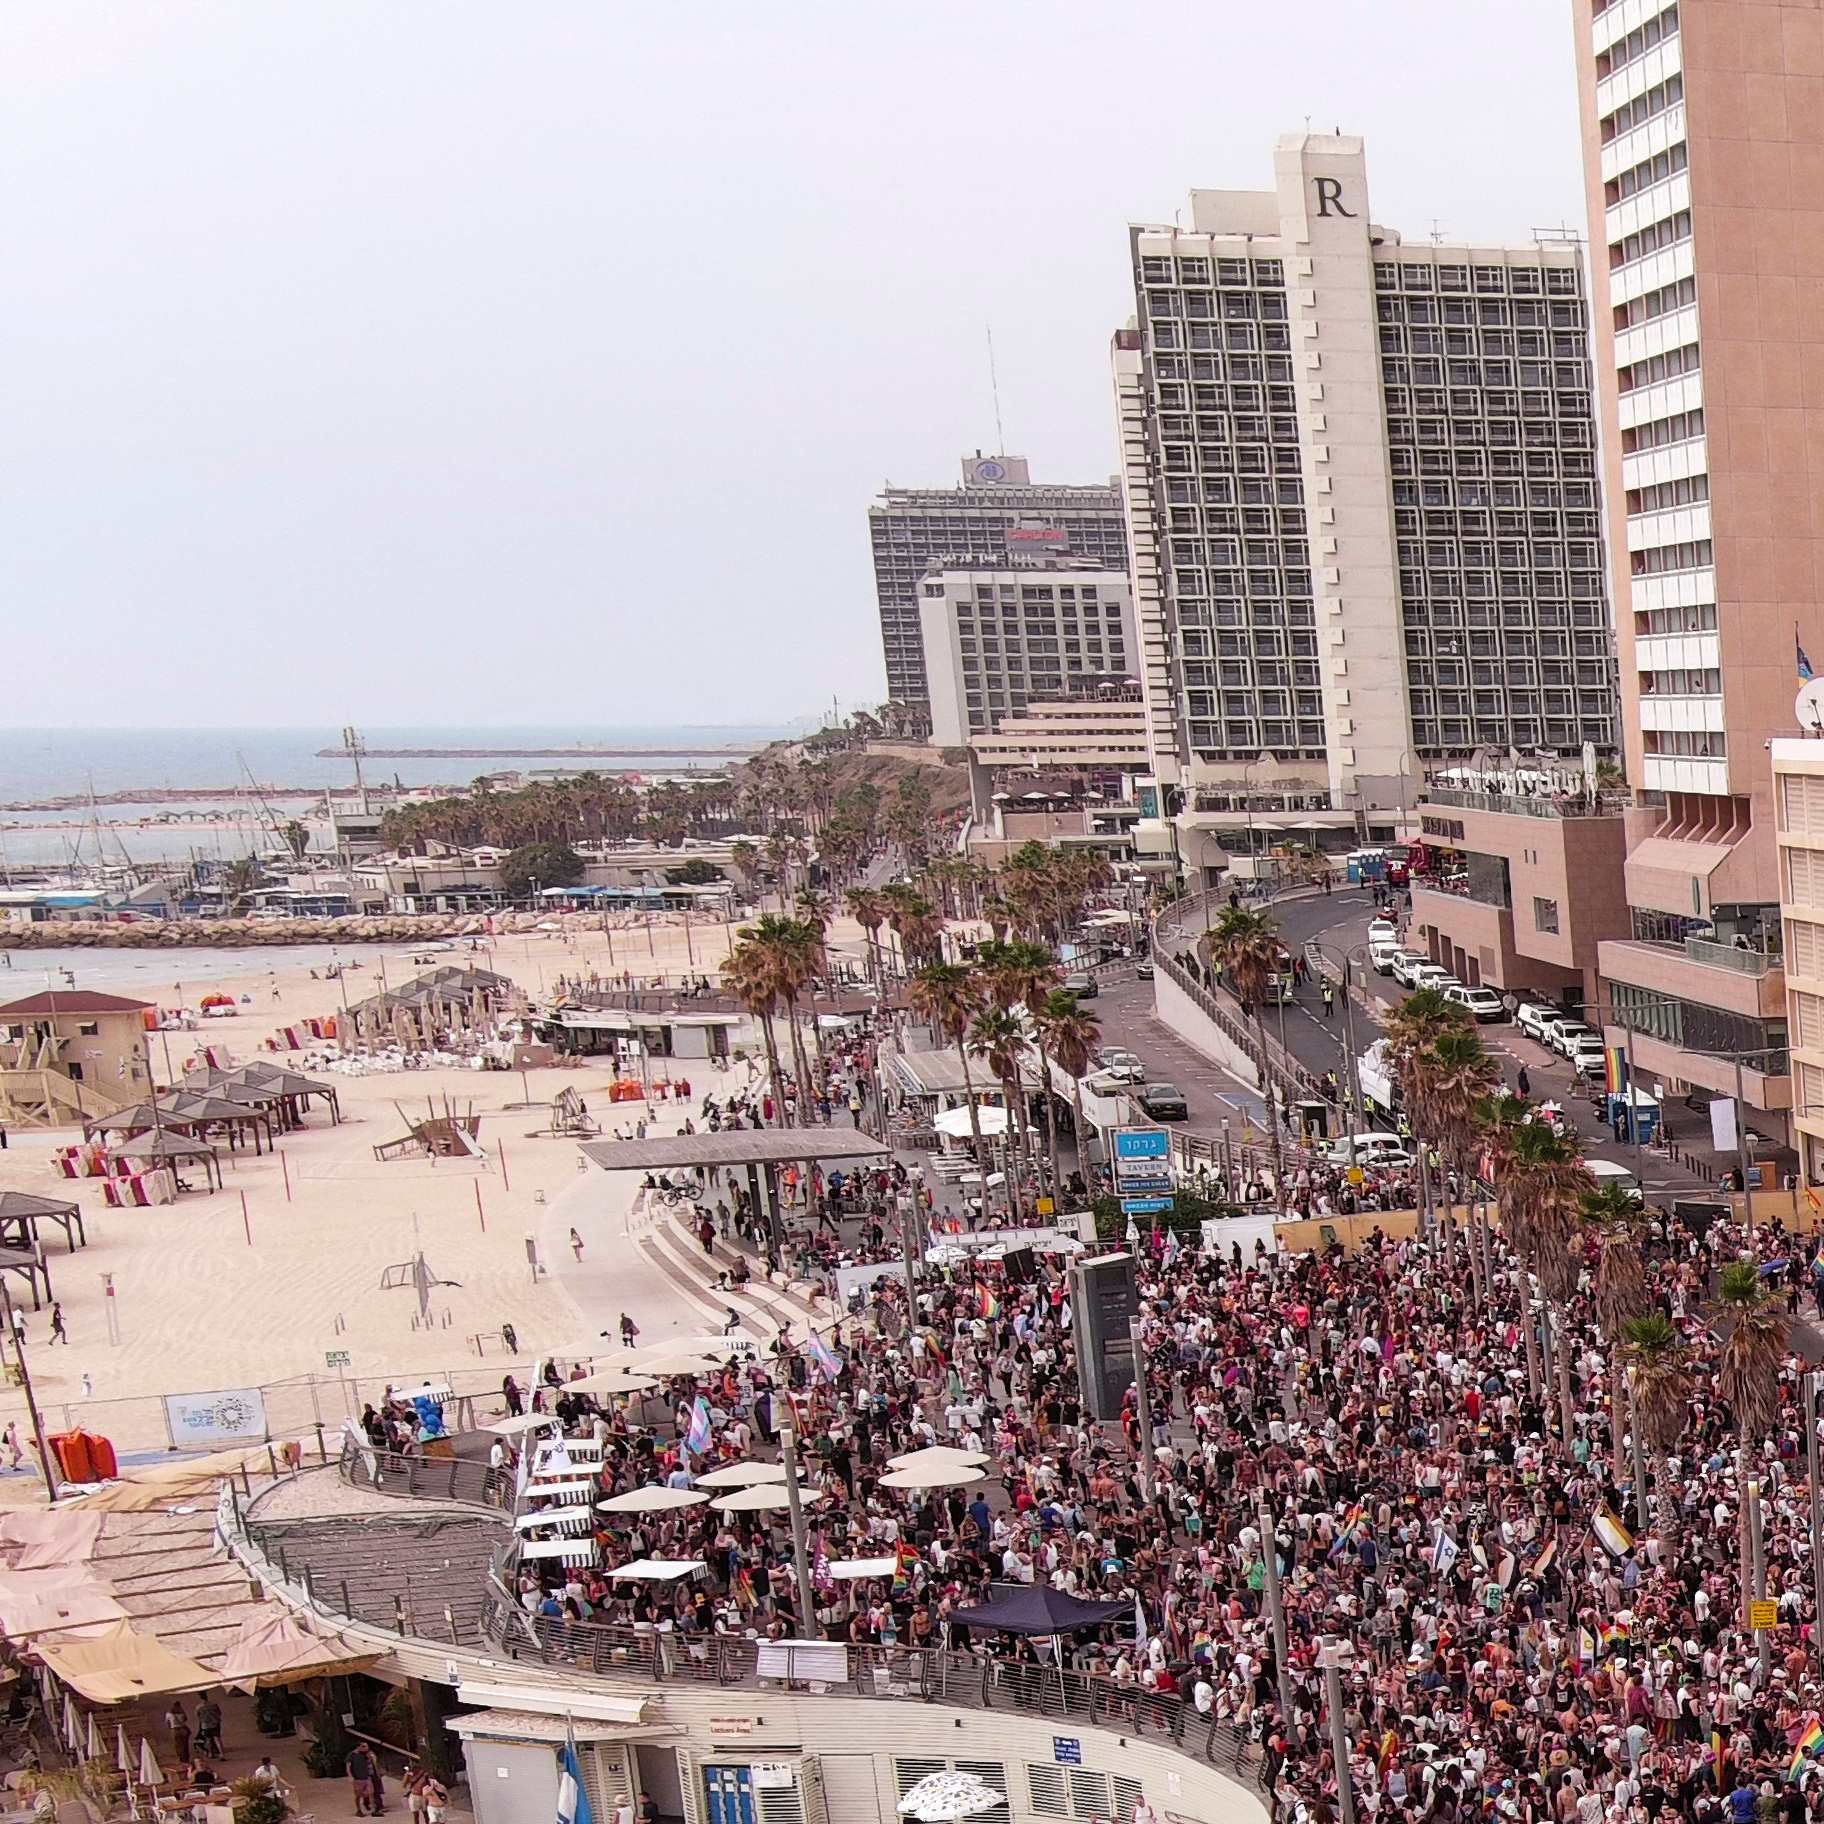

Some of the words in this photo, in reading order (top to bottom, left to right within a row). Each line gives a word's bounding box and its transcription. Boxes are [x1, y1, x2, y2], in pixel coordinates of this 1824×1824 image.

[1313, 177, 1357, 218] R
[1126, 1139, 1157, 1151] גרקו
[1126, 1163, 1163, 1172] TAVERN
